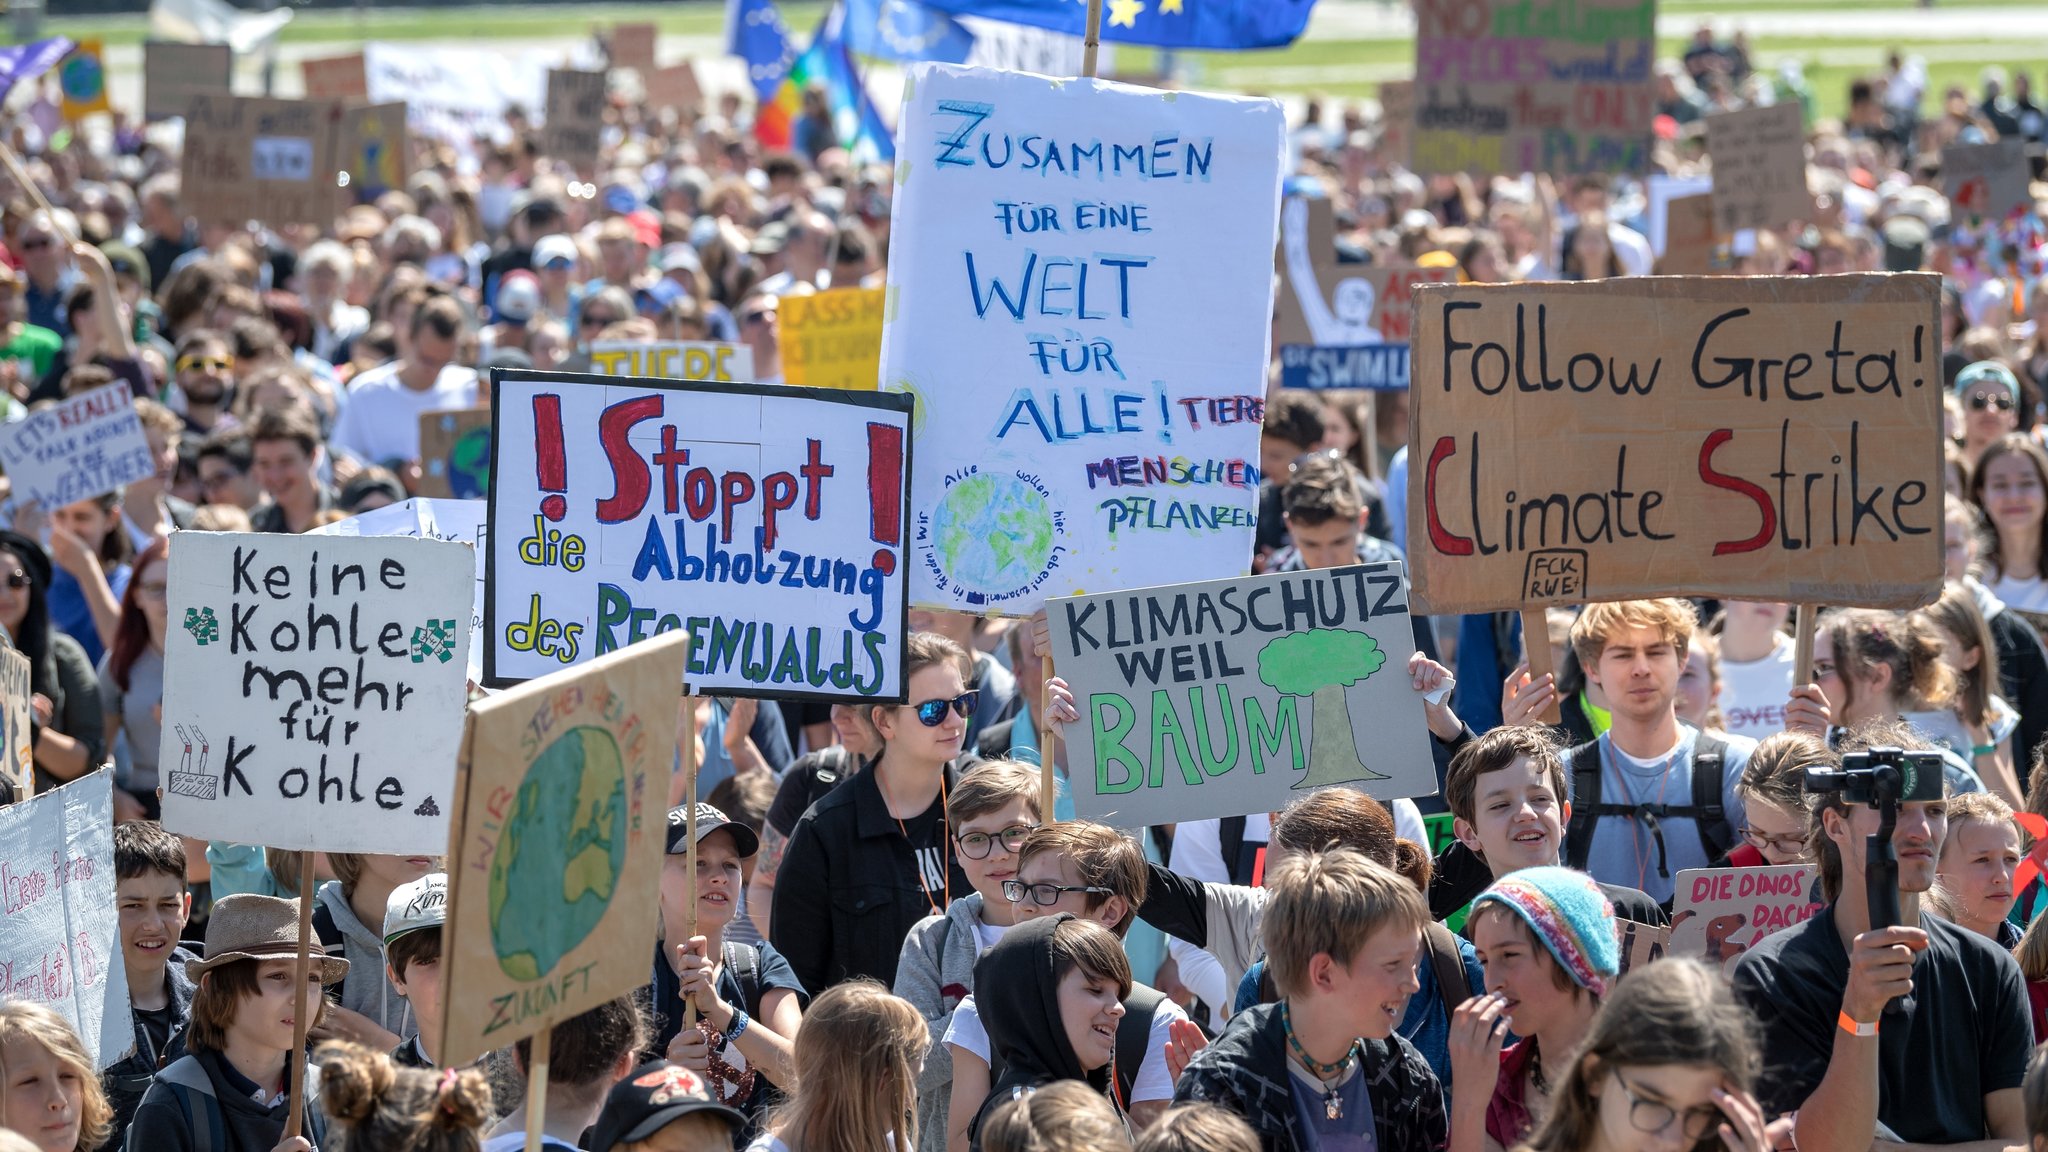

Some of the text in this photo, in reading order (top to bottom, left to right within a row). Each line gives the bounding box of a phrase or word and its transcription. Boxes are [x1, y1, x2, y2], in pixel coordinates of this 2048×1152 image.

[932, 99, 1214, 183] ZUSAMMEN
[994, 199, 1063, 238] FÜR
[962, 248, 1155, 328] WELT
[1026, 331, 1127, 380] FÜR
[1441, 301, 1662, 397] Follow
[1691, 306, 1924, 403] Greta!
[596, 393, 835, 552] Stoppt
[1015, 469, 1050, 498] wollen
[1425, 417, 1932, 558] Climate Strike
[232, 545, 407, 600] Keine
[518, 514, 886, 631] die Abholzung
[1534, 557, 1578, 578] FCK
[230, 600, 409, 658] Kohle
[505, 594, 585, 663] des
[1065, 563, 1408, 657] KLIMASCHUTZ
[242, 656, 414, 712] mehr
[1114, 640, 1245, 688] WEIL
[278, 699, 361, 748] für
[1089, 683, 1306, 797] BAUM
[471, 785, 514, 871] WIR
[1691, 870, 1806, 904] DIE DINOS
